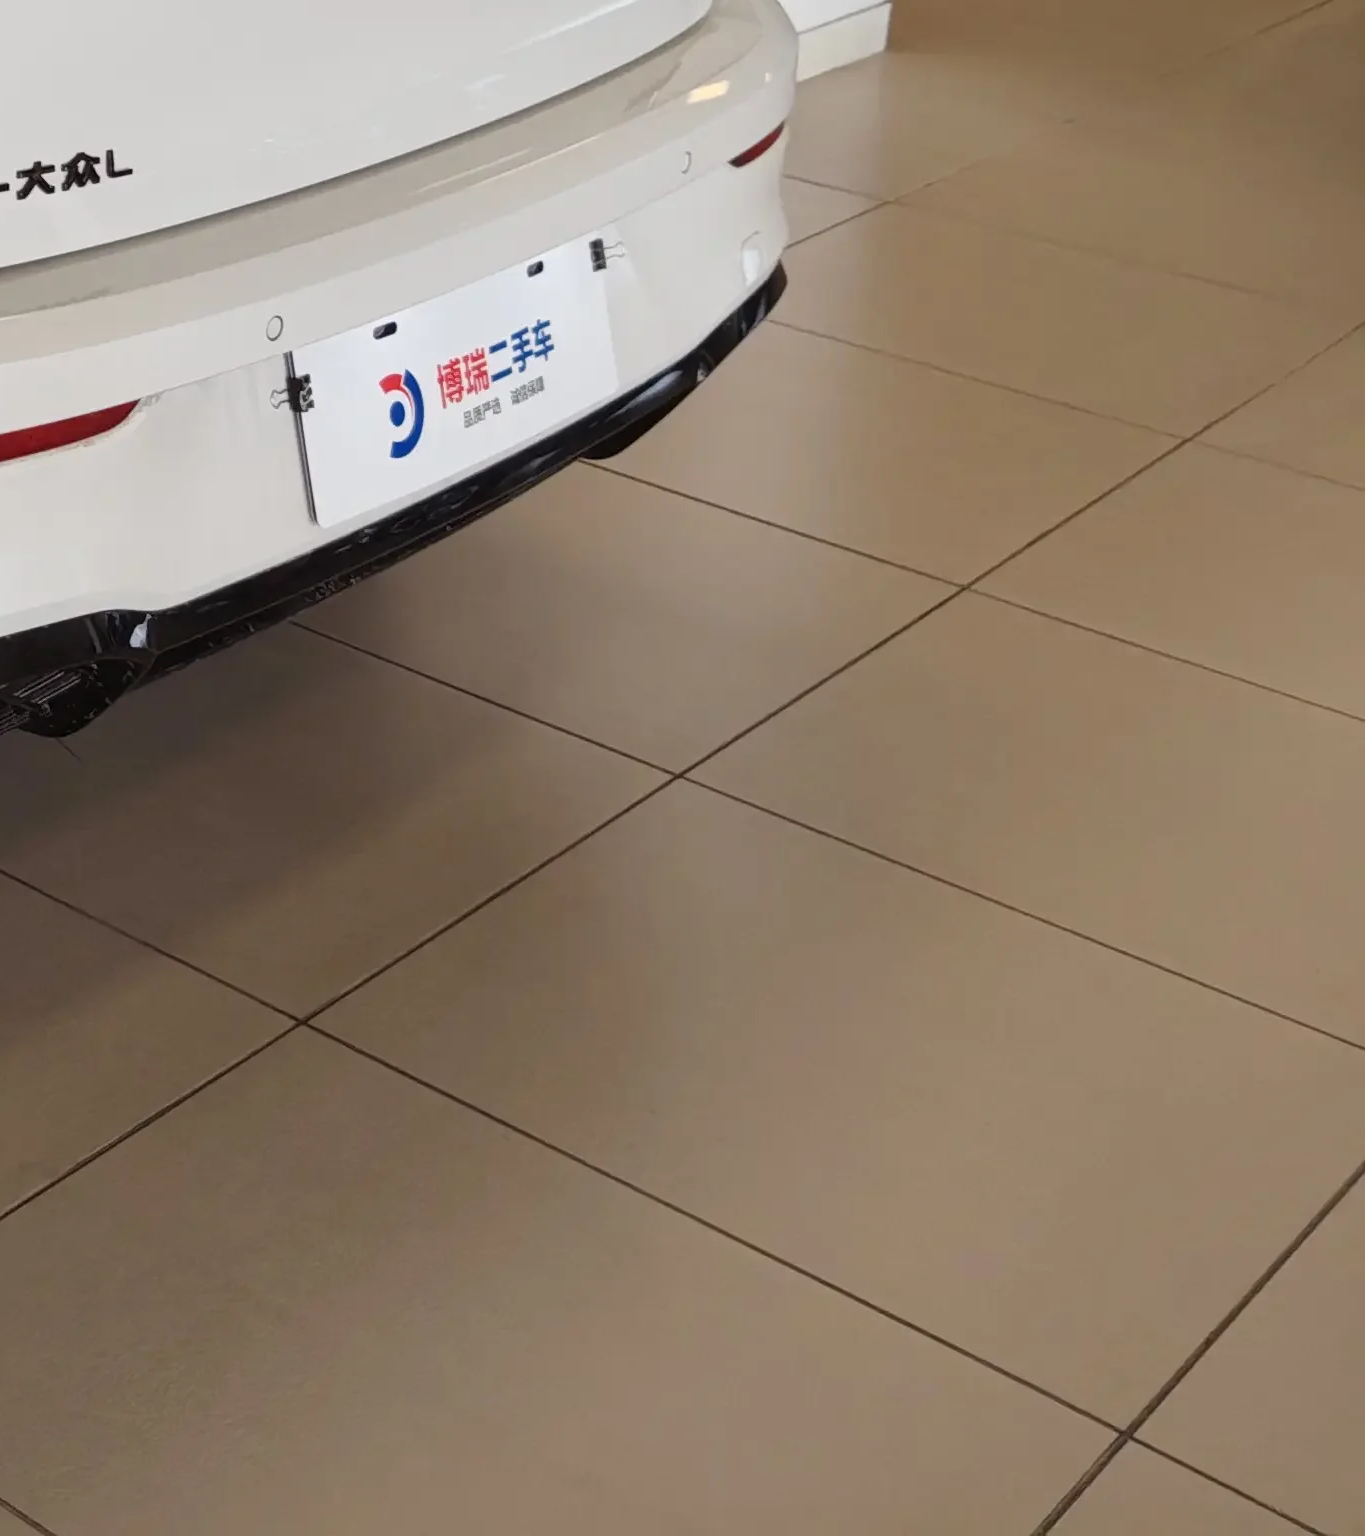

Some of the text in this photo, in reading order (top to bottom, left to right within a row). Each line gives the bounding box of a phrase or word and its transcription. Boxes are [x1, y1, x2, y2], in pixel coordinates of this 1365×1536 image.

[436, 319, 555, 409] 博瑞二手车
